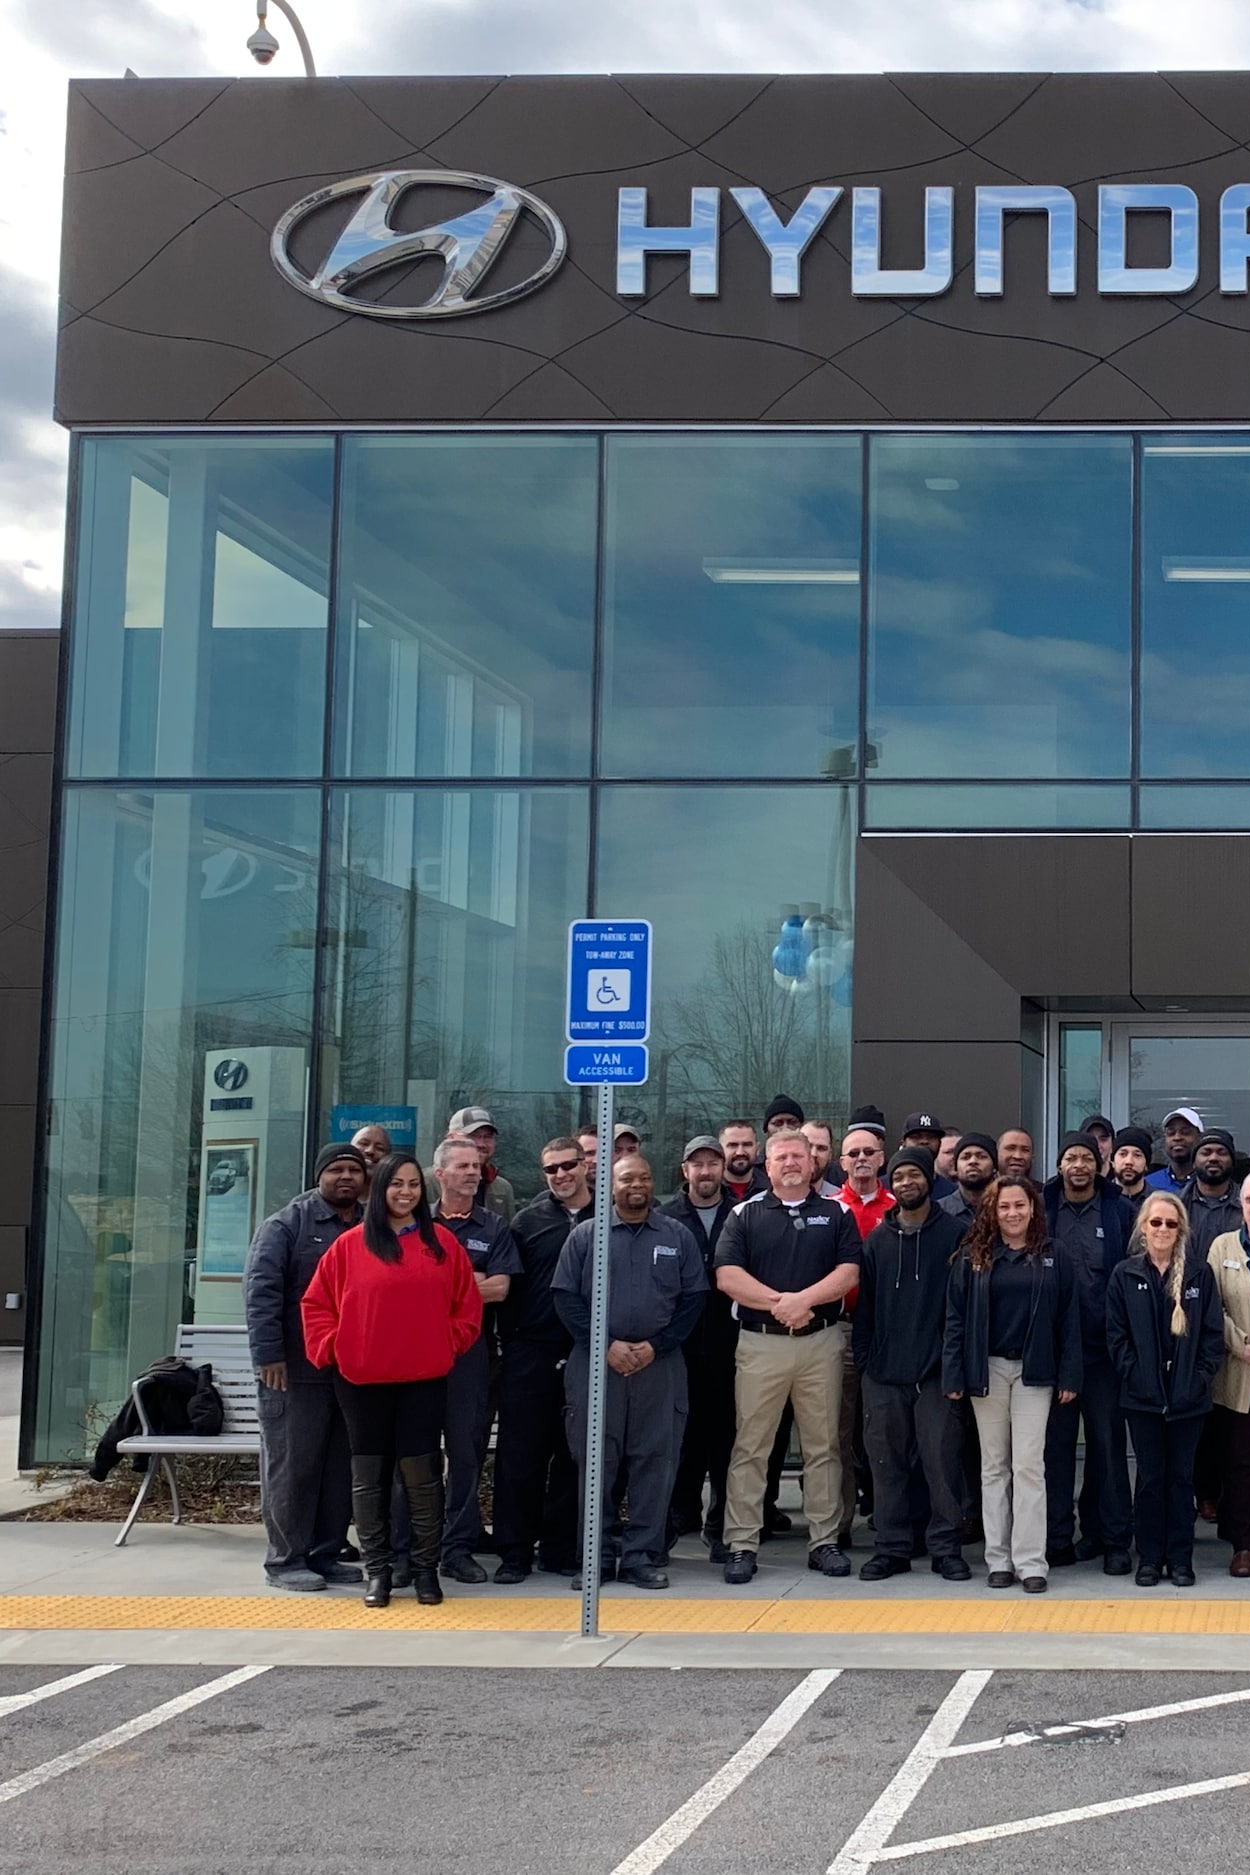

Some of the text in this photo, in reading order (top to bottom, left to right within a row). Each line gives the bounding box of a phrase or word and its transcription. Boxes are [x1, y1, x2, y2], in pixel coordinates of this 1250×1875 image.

[575, 933, 645, 942] PERMIT PARKING ONLY
[585, 950, 635, 960] TOW-AWAY ZONE
[570, 1021, 600, 1030] MAXIMUM
[601, 1021, 615, 1030] FINE
[592, 1053, 621, 1065] VAN
[578, 1066, 634, 1076] ACCESSIBLE
